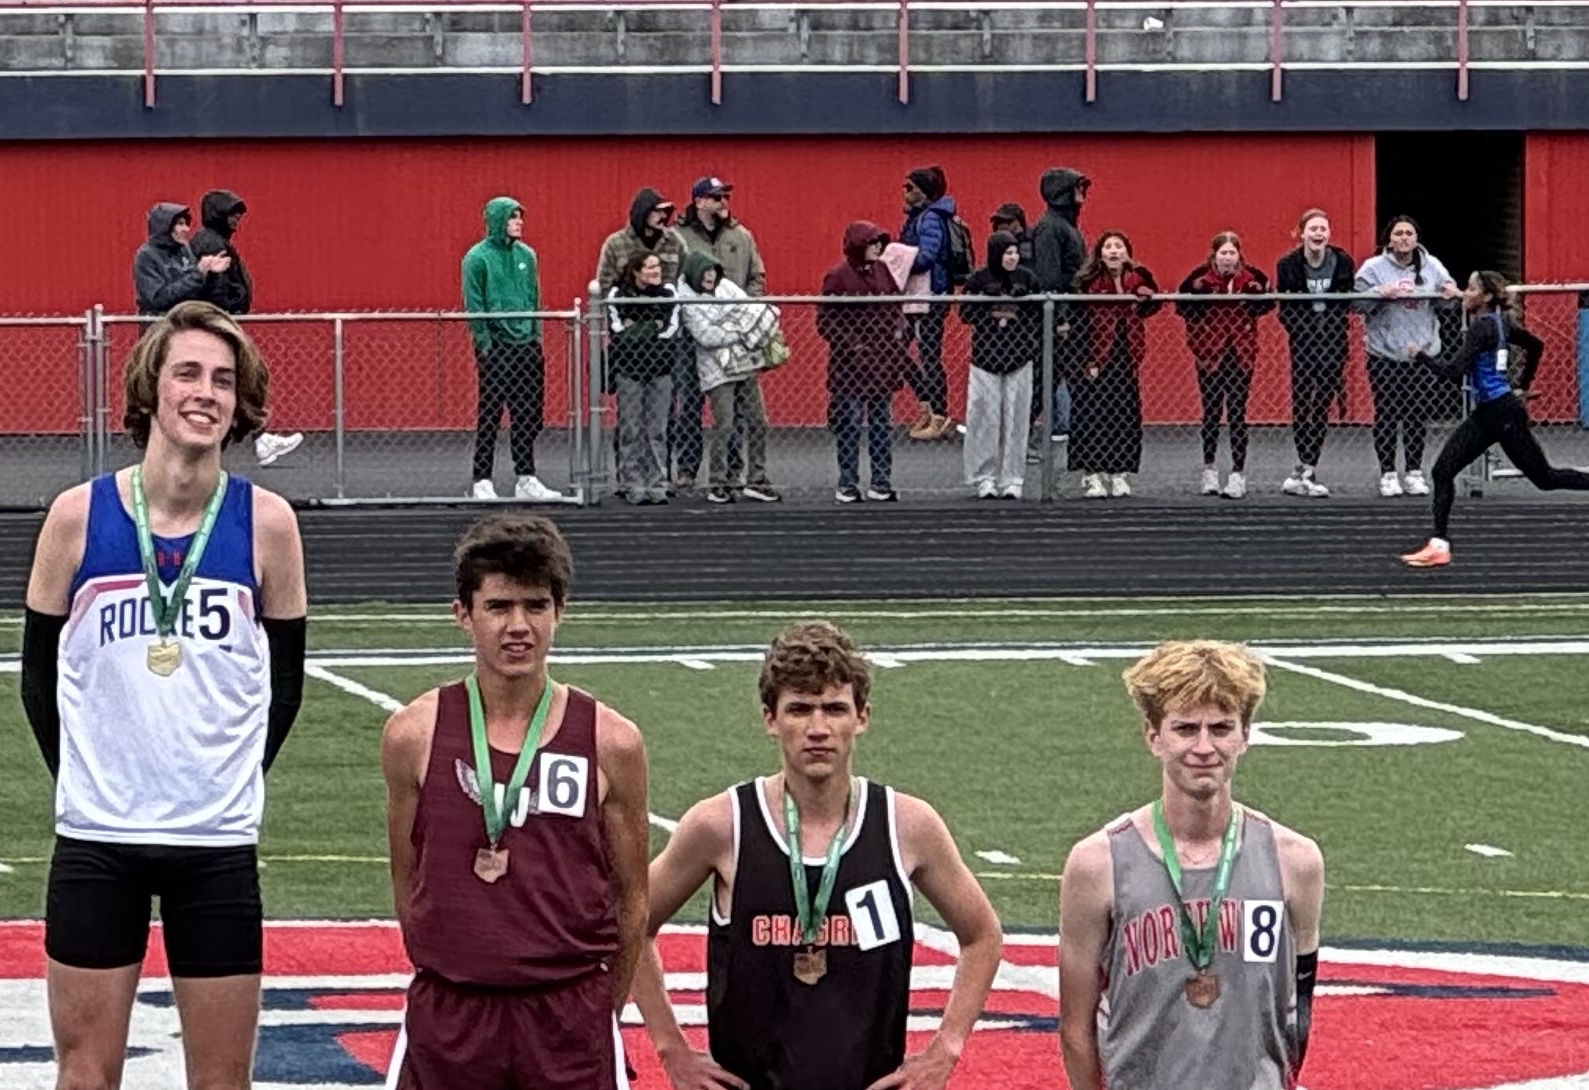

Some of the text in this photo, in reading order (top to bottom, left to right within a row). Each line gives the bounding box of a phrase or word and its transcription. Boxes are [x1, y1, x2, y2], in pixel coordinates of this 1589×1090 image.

[198, 588, 231, 640] 5
[547, 758, 580, 809] 6
[855, 889, 886, 942] 1
[1250, 904, 1277, 958] 8
